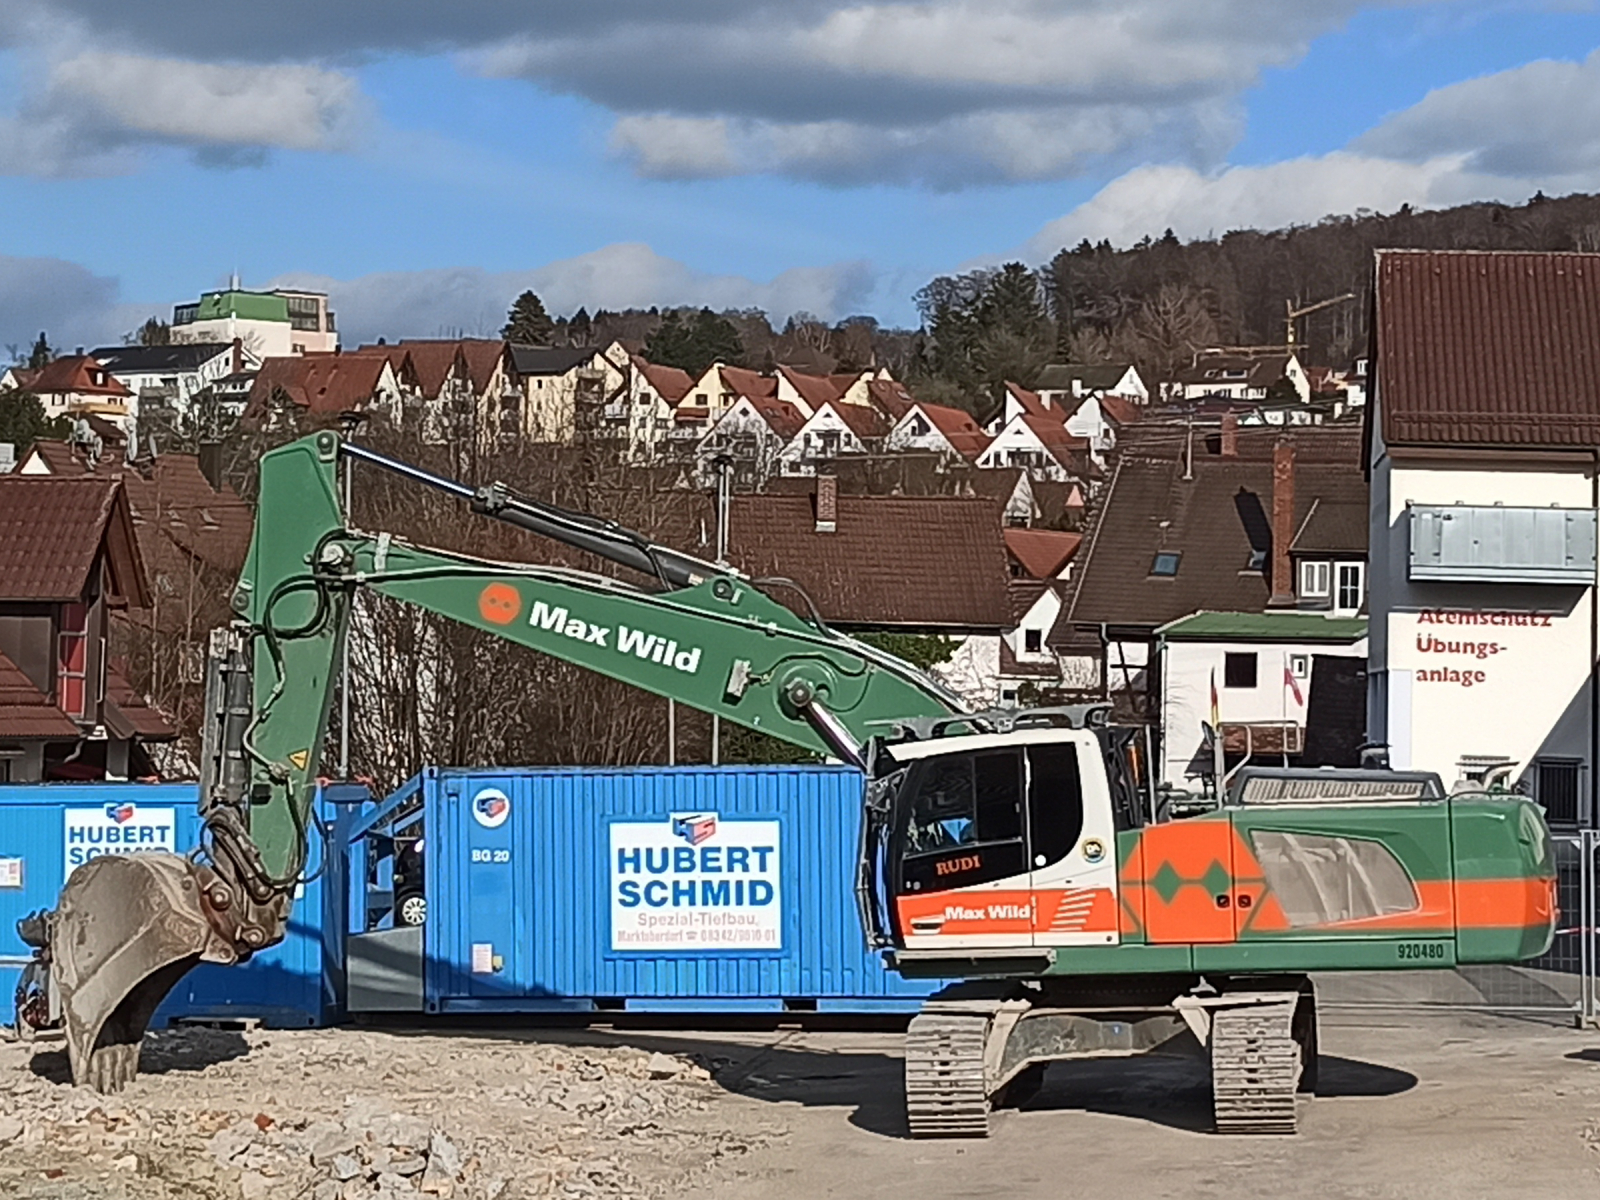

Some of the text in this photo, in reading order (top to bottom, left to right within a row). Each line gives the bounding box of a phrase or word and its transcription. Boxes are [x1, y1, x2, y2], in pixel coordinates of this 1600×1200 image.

[1416, 609, 1552, 627] Atemschutz
[529, 600, 702, 673] Max Wild
[1416, 632, 1507, 659] Übungs-
[1416, 667, 1486, 687] anlage
[69, 825, 170, 843] HUBERT
[471, 849, 509, 862] BG 20
[617, 846, 774, 874] HUBERT
[936, 855, 981, 875] RUDI
[617, 880, 774, 907] SCHMID
[944, 904, 1031, 920] Max Wild
[1397, 943, 1444, 959] 920480
